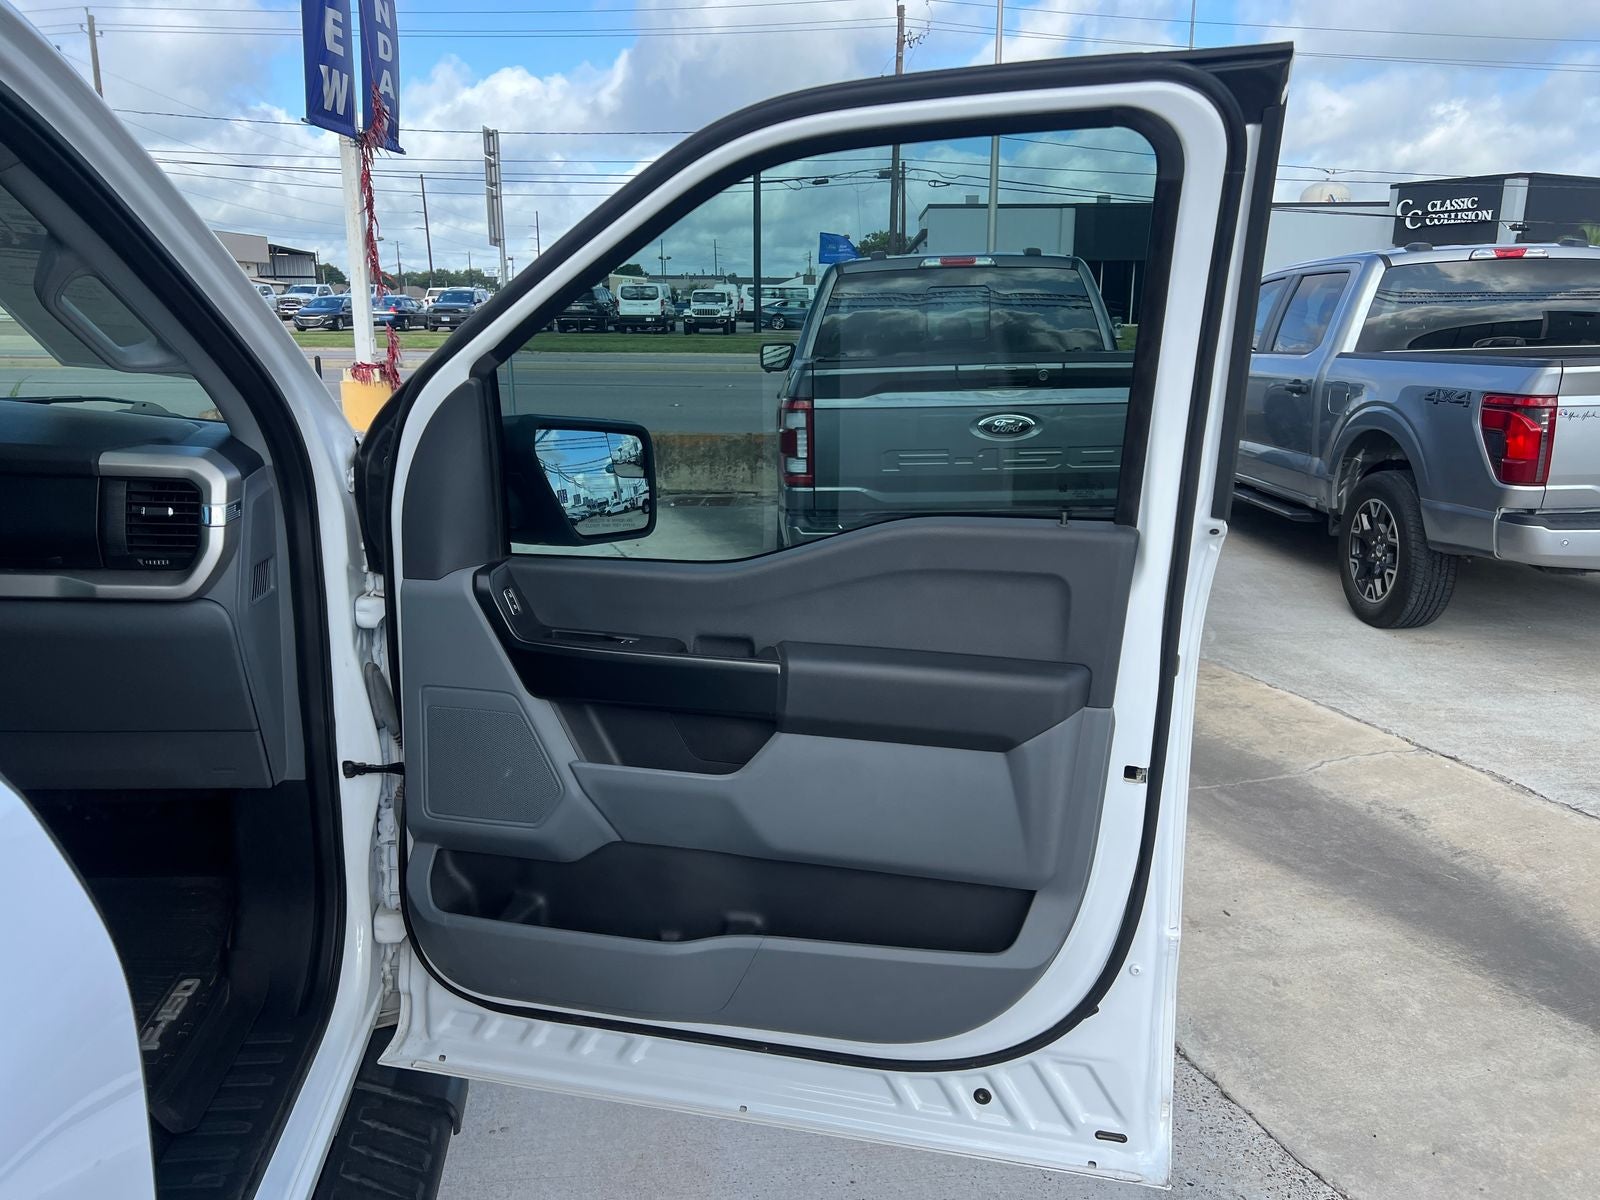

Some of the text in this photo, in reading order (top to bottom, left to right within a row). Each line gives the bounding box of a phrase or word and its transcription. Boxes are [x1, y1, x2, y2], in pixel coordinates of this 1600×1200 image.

[1427, 196, 1478, 212] CLASSIC
[1425, 209, 1494, 226] COLLISION
[991, 419, 1022, 433] Ford
